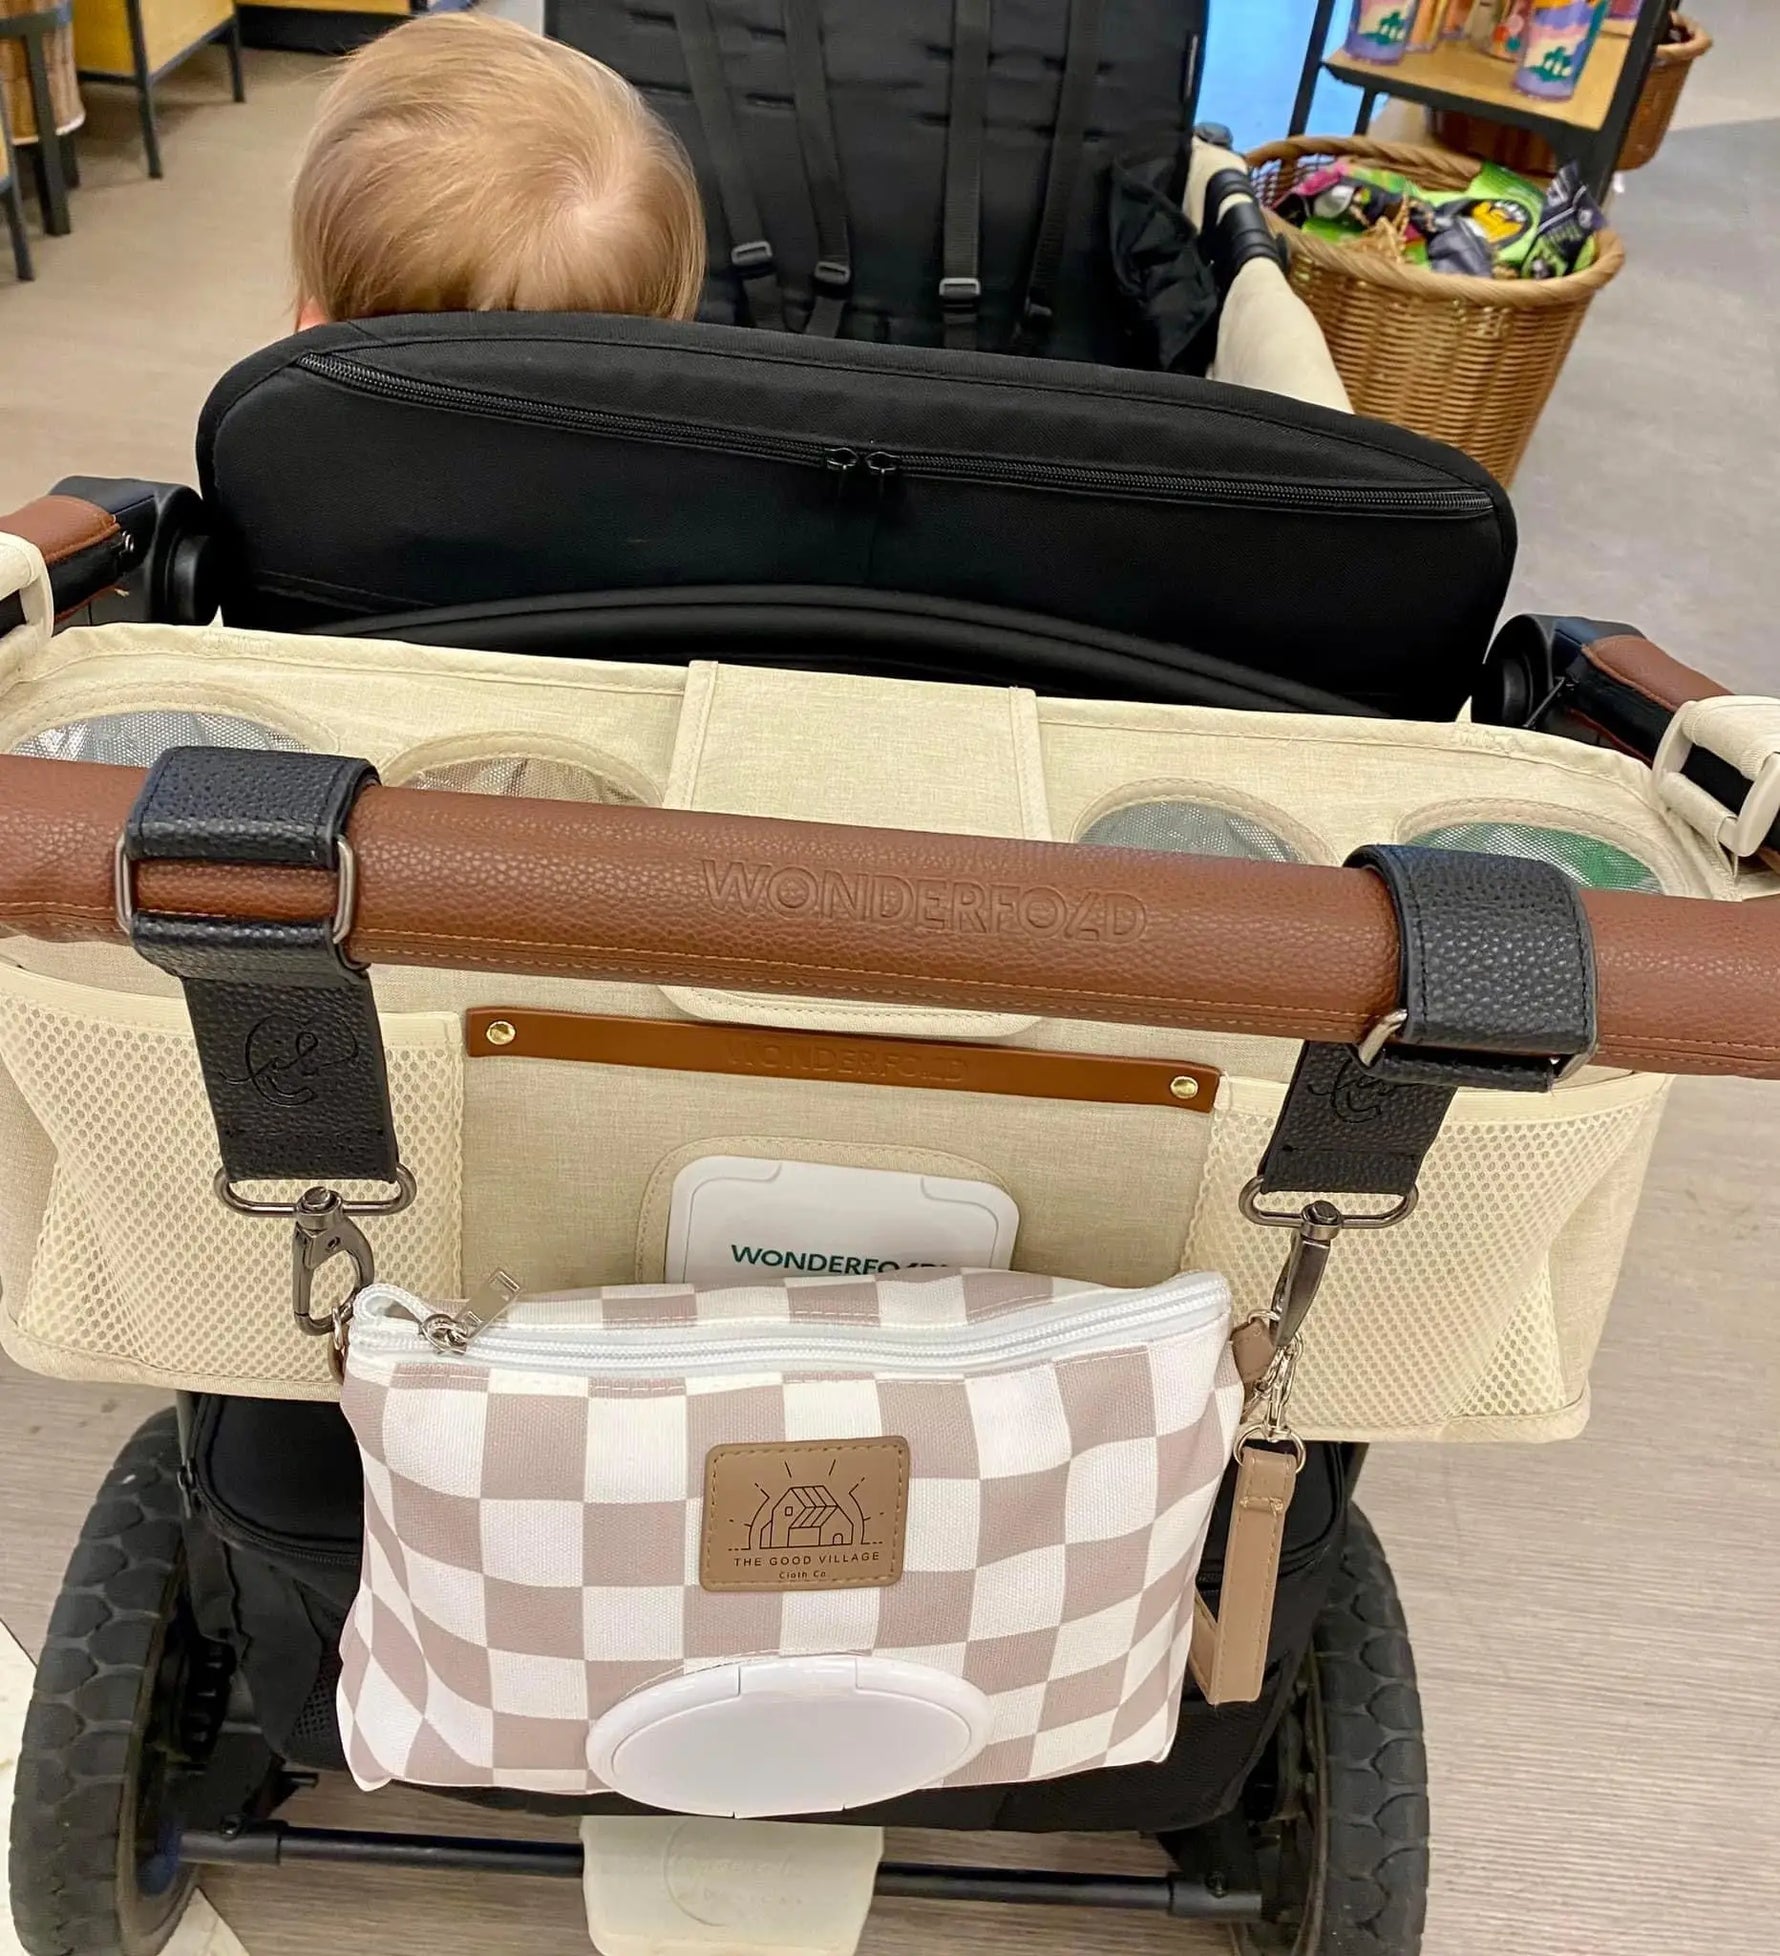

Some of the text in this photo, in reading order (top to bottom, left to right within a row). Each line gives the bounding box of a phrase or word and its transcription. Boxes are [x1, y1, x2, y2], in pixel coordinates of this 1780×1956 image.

[701, 859, 1147, 944] WONDERFOLD
[731, 1244, 948, 1275] WONDERFO
[734, 1551, 880, 1567] THE GOOD VILLAGE
[779, 1569, 807, 1579] Cloth
